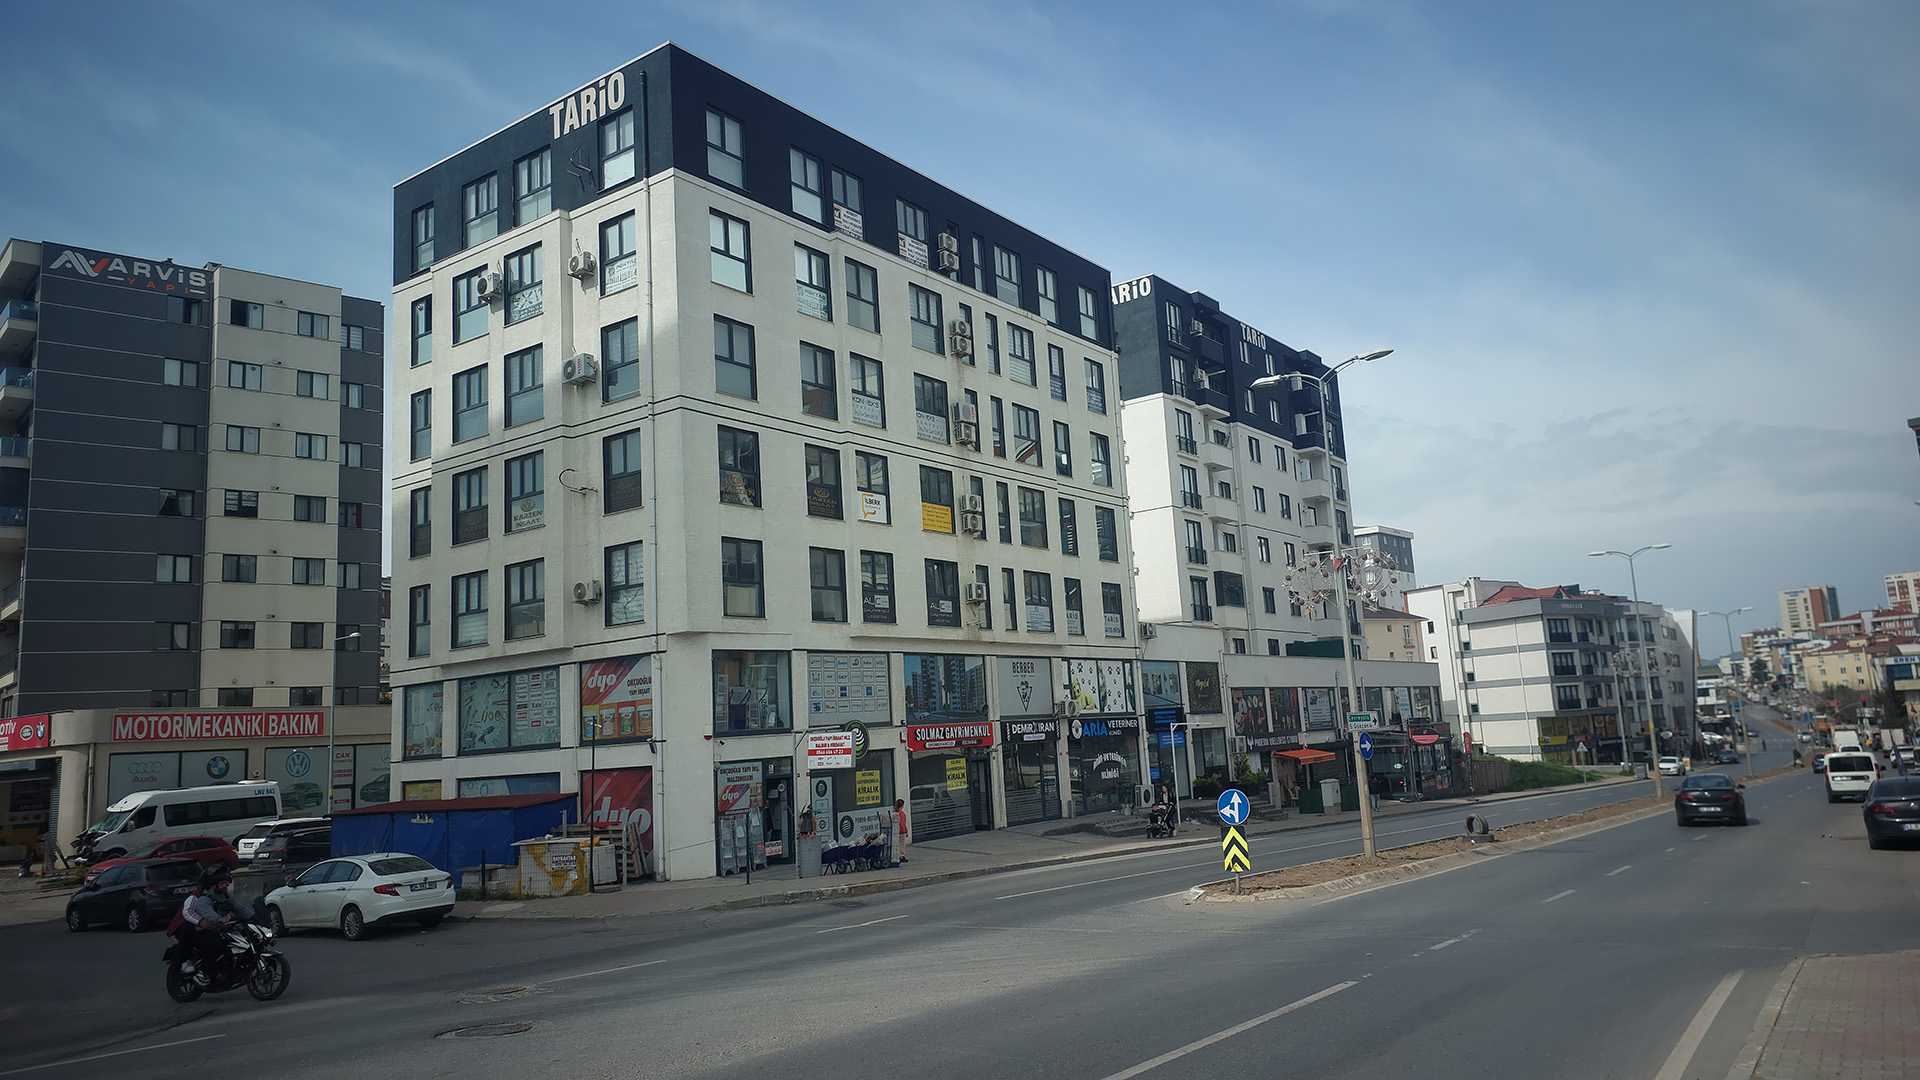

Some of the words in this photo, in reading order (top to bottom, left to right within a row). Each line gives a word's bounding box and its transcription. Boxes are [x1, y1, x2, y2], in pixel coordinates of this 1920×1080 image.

[1012, 661, 1035, 674] BERBER
[587, 670, 617, 692] dyo
[115, 714, 183, 739] MOTOR
[268, 714, 319, 736] BAKIM
[915, 726, 944, 741] SOLMAZ
